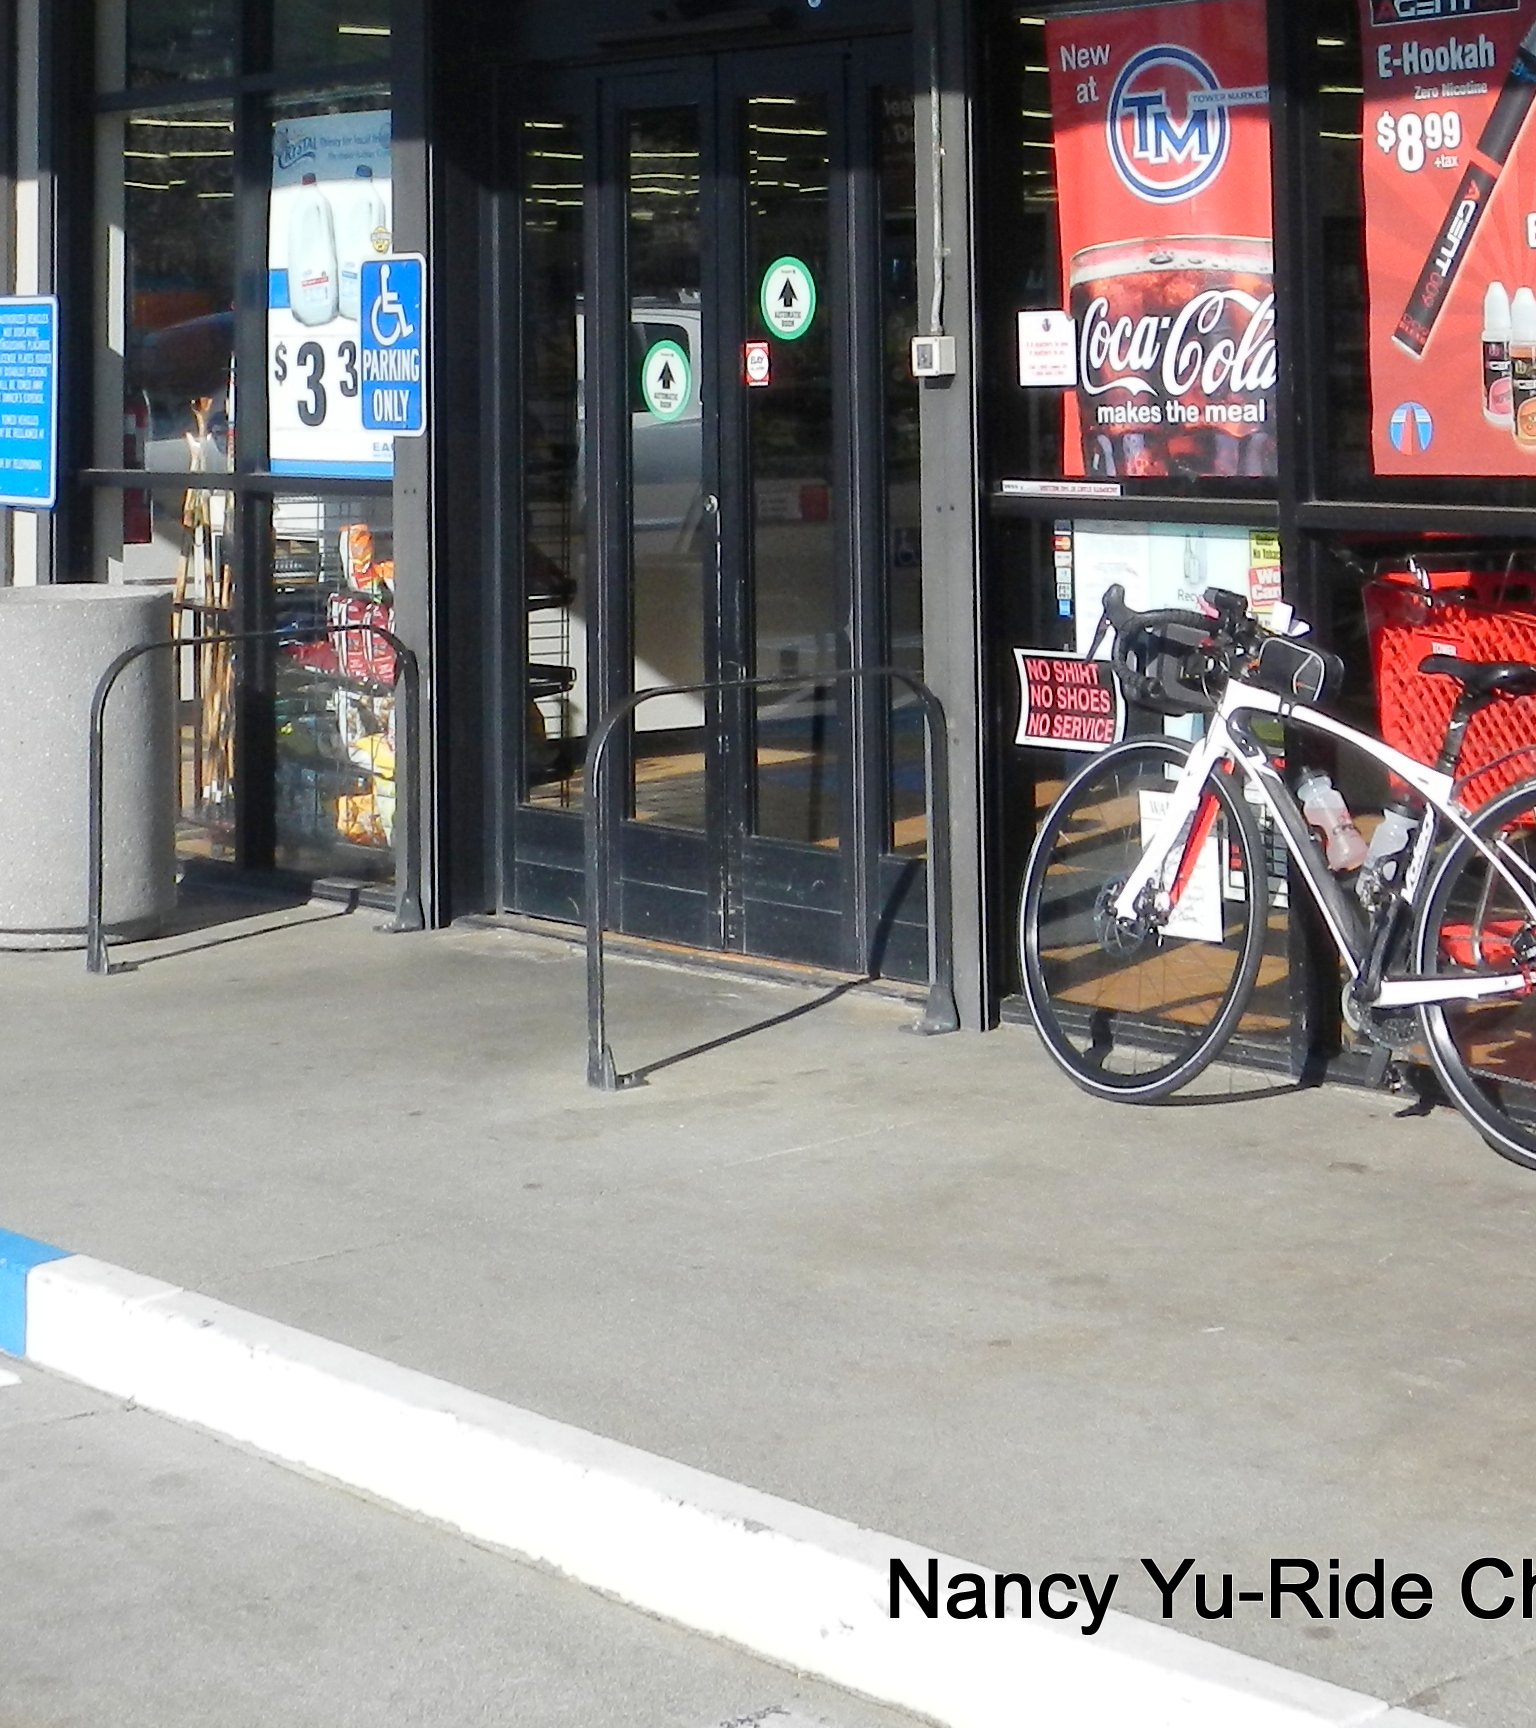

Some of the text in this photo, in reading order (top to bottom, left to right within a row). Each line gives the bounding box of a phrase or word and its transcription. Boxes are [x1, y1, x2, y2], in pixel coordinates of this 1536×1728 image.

[1060, 43, 1110, 72] New
[1377, 33, 1495, 78] E-Hookah
[1076, 76, 1099, 103] at
[1192, 89, 1270, 104] TOWER MARKET
[1414, 81, 1488, 100] Zero Nicotine
[1080, 288, 1278, 397] Coca-Cola
[363, 348, 420, 382] PARKING
[373, 389, 410, 422] ONLY
[1098, 399, 1266, 423] makes the meal
[1025, 659, 1051, 683] NO
[1029, 685, 1111, 714] NO SHOES
[1028, 712, 1115, 743] NO SERVICE
